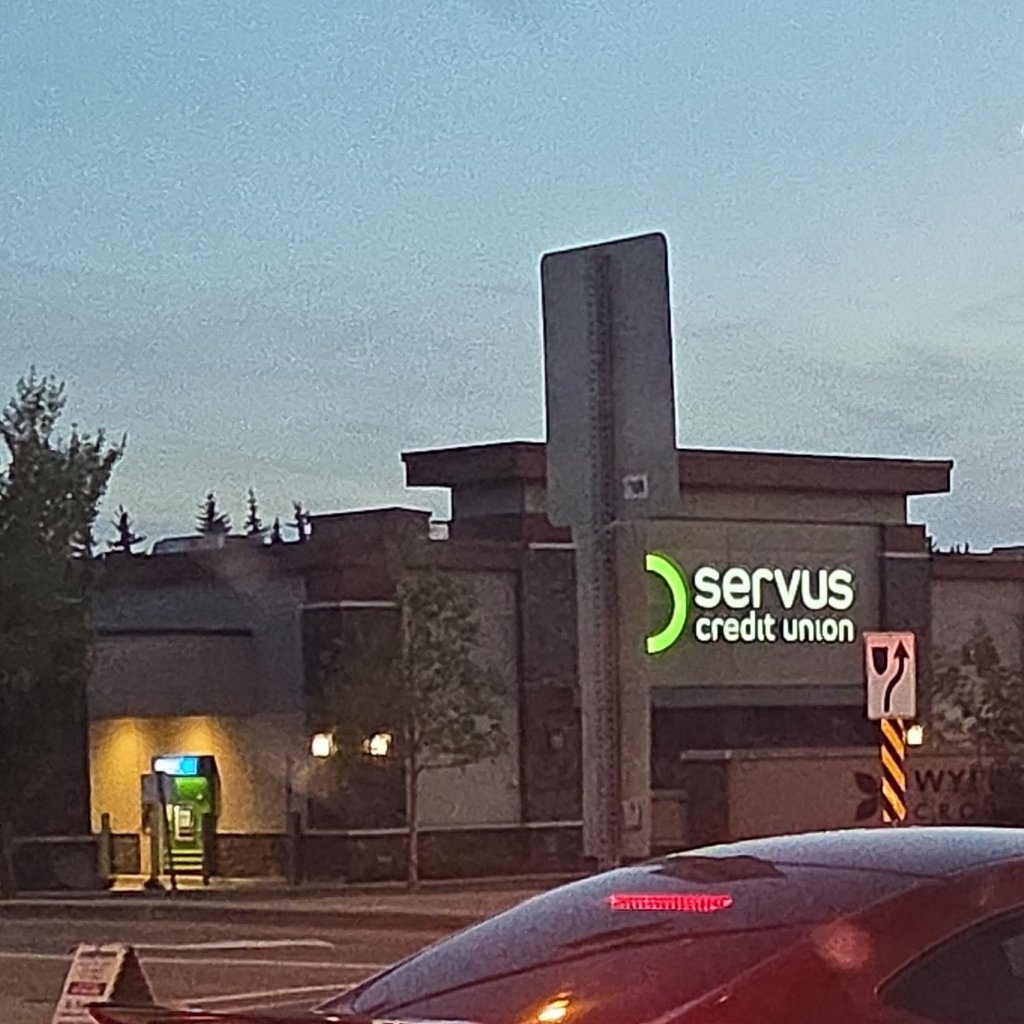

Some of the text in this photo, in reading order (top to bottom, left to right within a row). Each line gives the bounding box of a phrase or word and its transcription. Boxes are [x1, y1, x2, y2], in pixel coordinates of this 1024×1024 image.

[694, 566, 854, 610] servus
[696, 610, 854, 642] credit union
